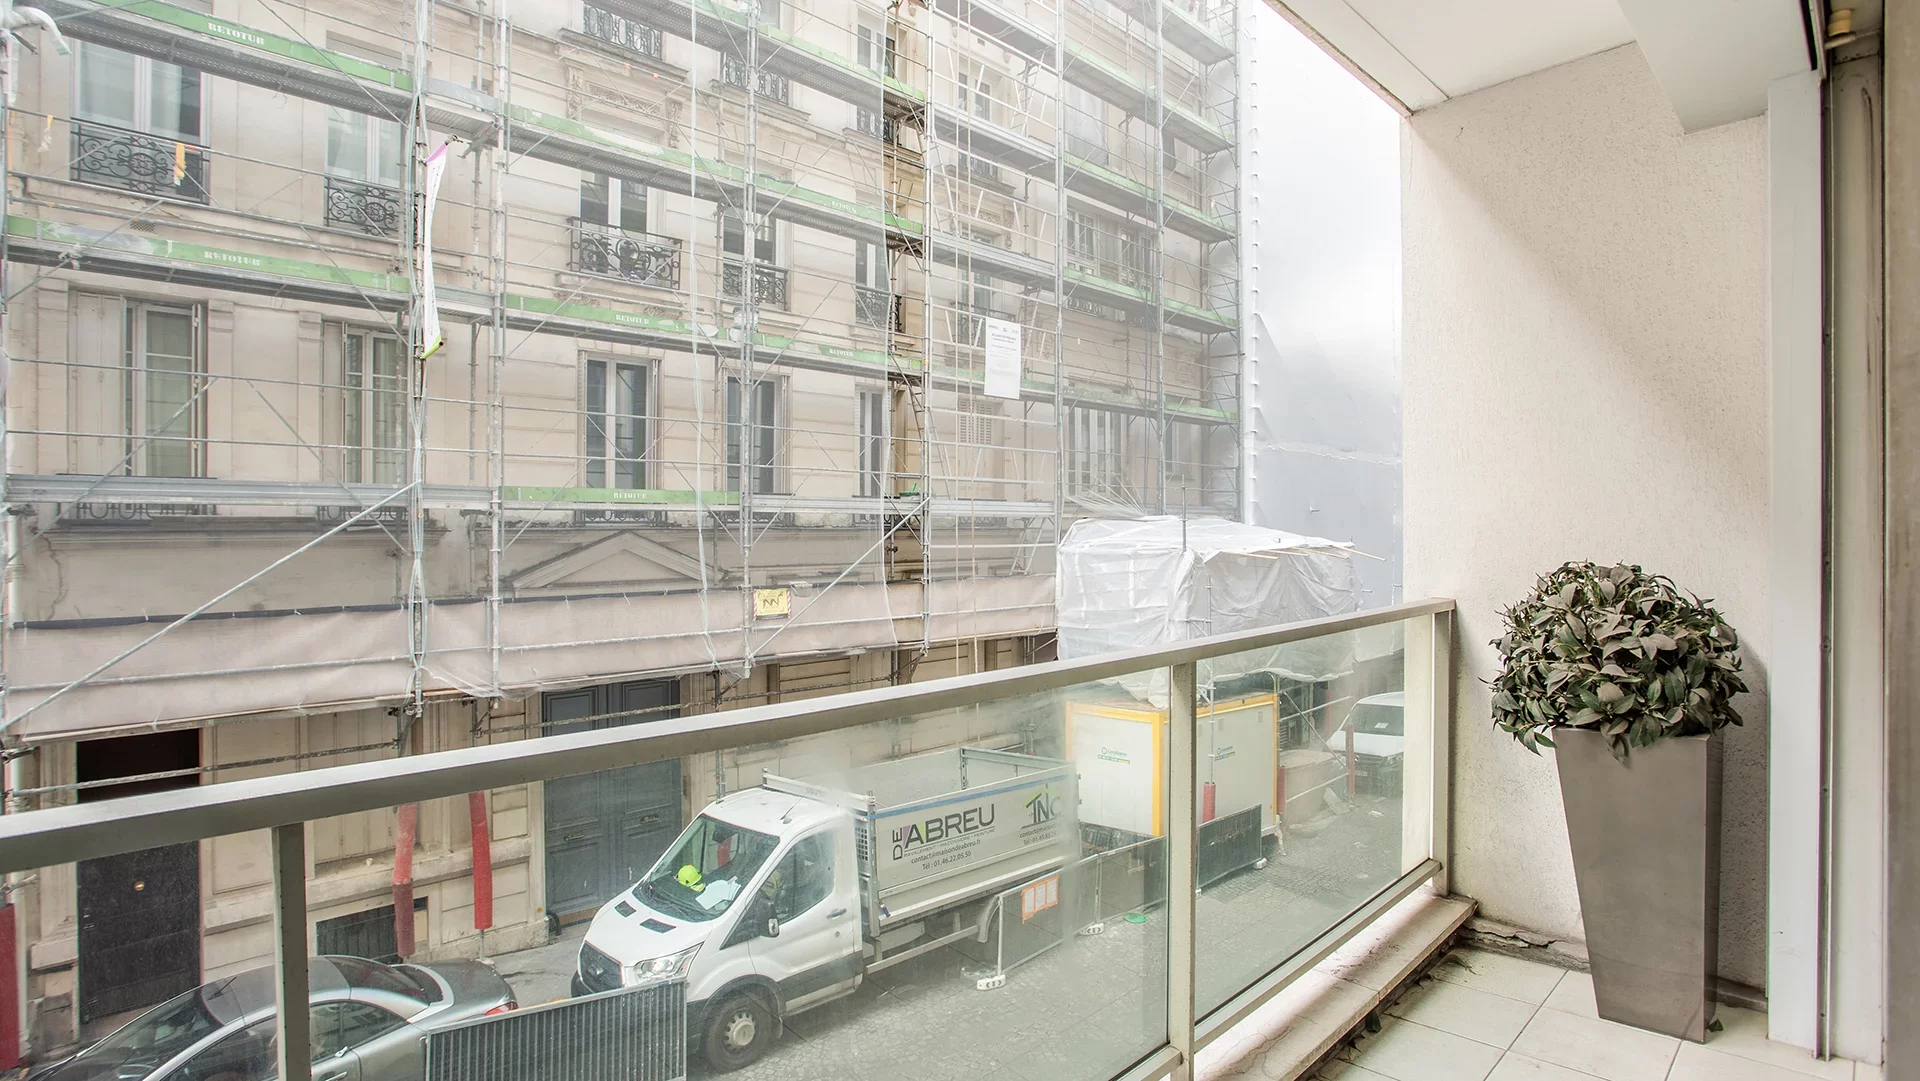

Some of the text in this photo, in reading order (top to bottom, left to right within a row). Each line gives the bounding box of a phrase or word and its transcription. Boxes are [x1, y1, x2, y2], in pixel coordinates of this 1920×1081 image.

[892, 803, 995, 861] DE ABREU
[911, 839, 981, 864] contact@maisondeabreu.fr
